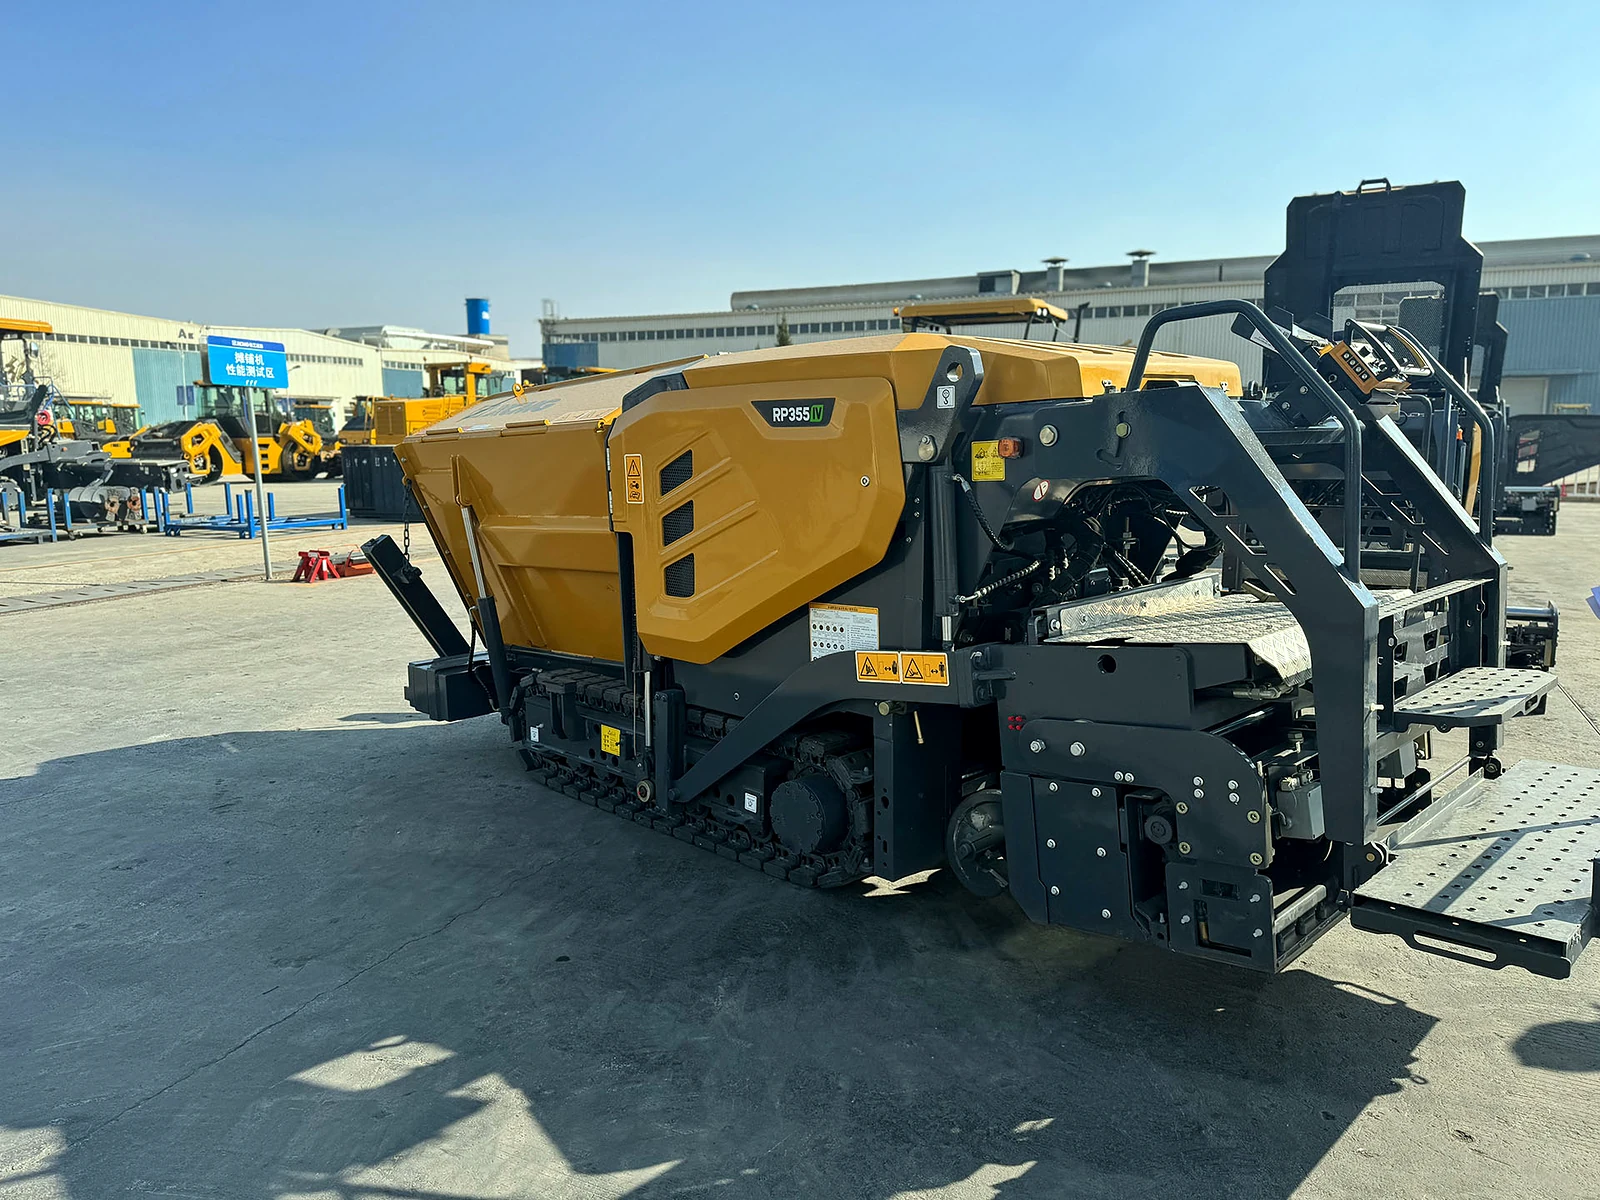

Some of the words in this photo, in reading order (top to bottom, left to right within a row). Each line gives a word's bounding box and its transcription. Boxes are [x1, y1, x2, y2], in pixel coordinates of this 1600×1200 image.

[234, 351, 264, 366] 摊铺机
[225, 363, 275, 379] 性能测试区
